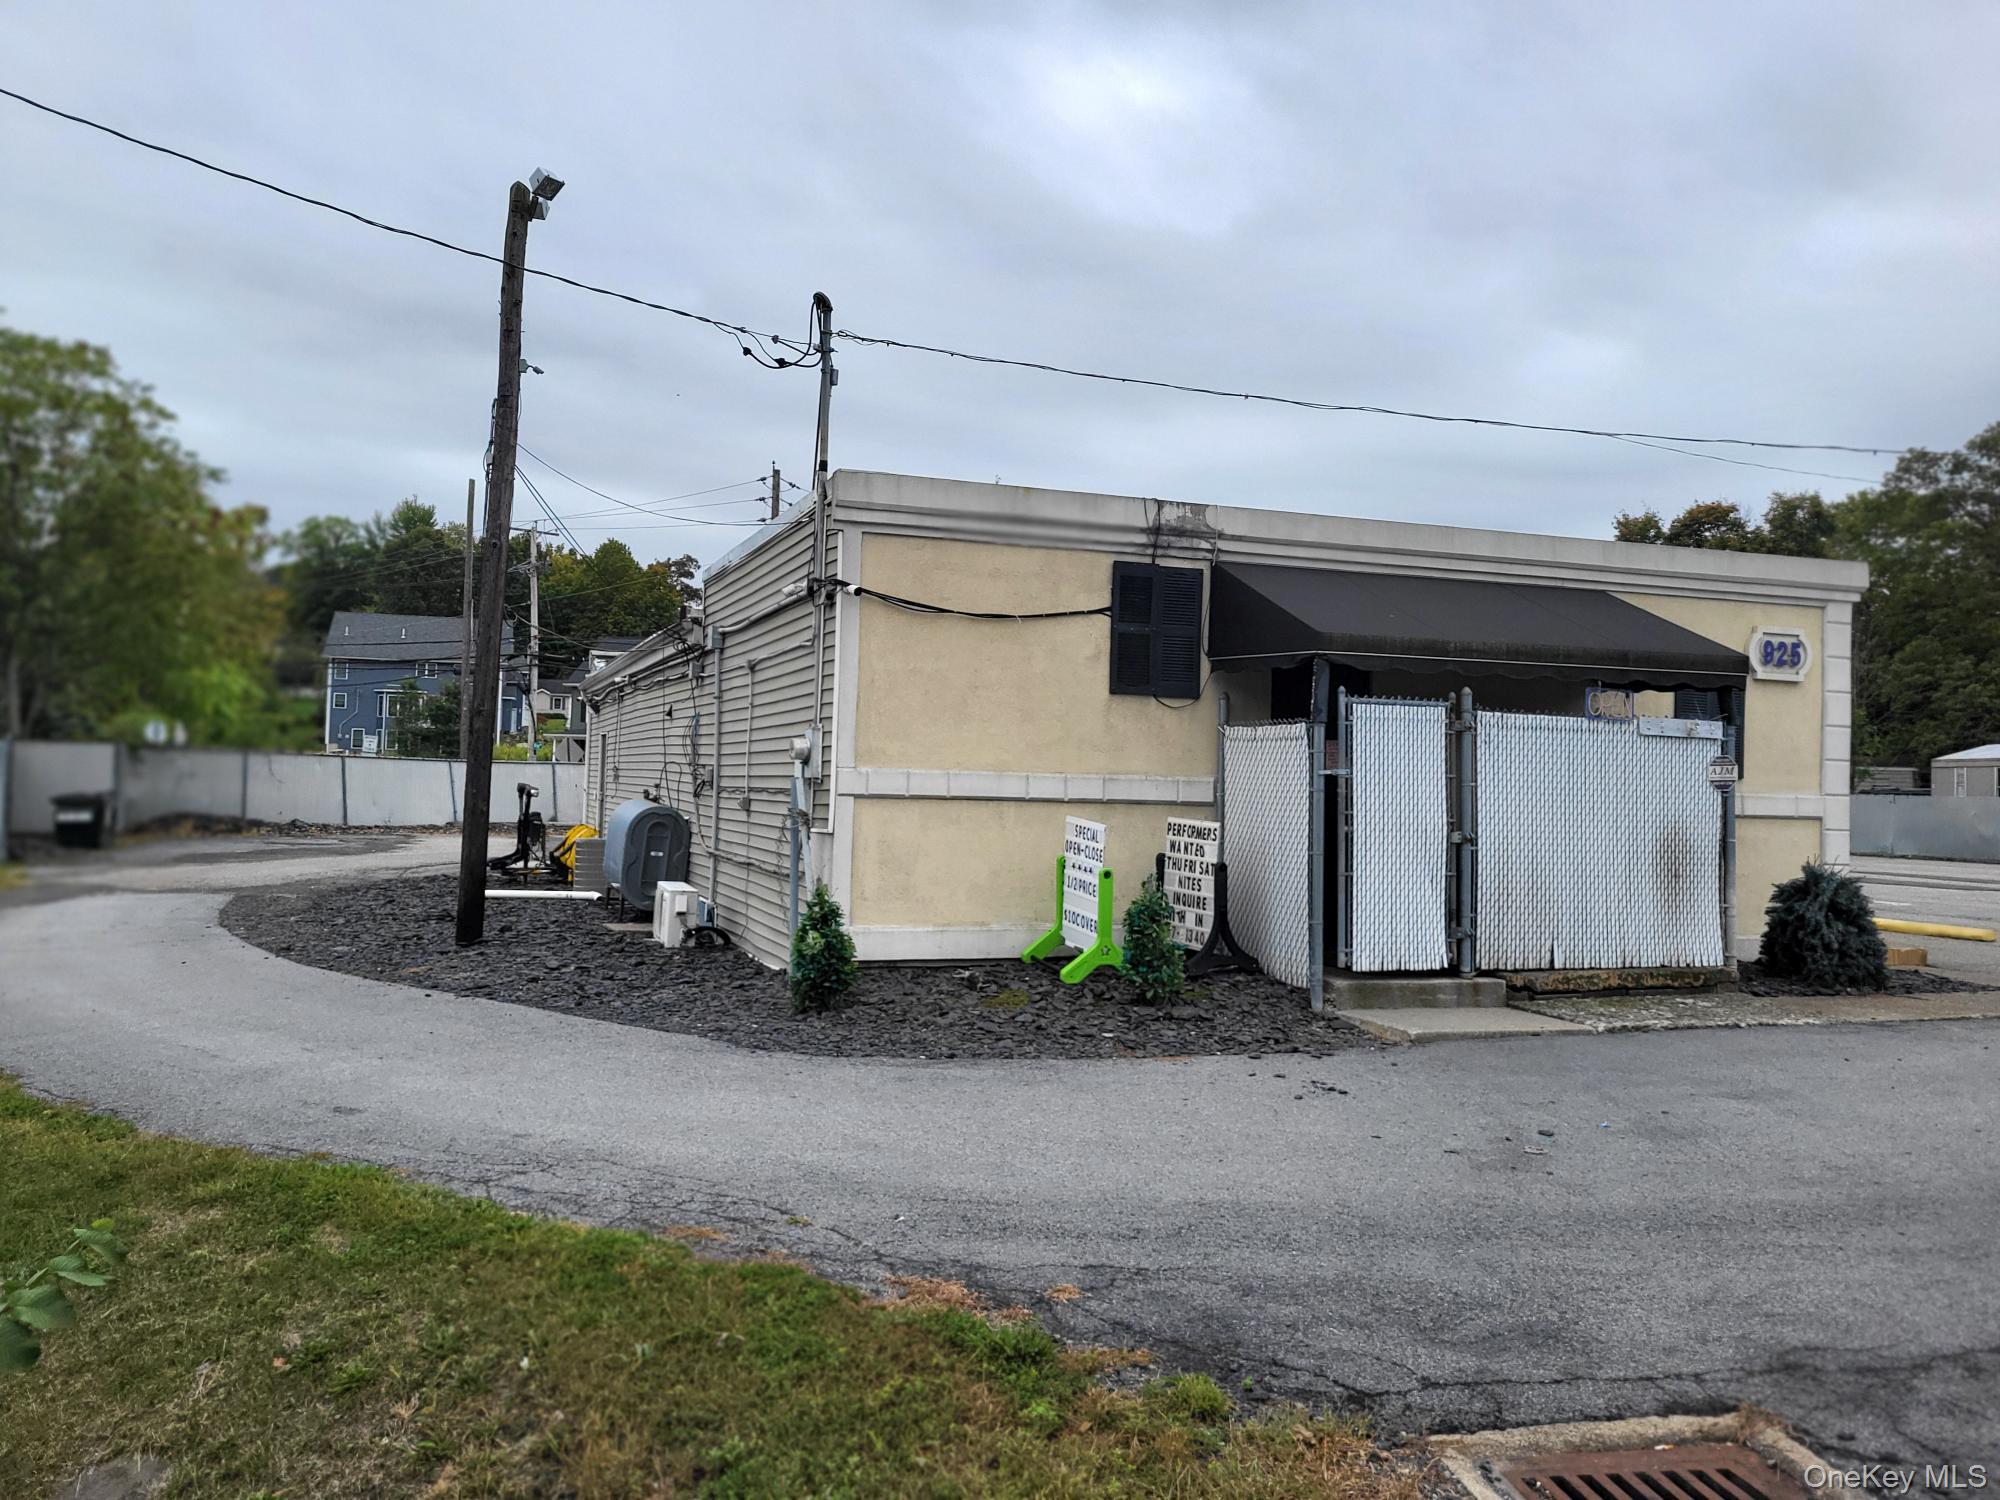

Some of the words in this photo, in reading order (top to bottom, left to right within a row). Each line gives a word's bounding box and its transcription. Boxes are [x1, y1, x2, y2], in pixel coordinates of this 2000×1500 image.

[1074, 824, 1100, 844] SPECIAL
[1065, 839, 1103, 863] OPEN-CLOSE
[1170, 839, 1205, 858] WANTED
[1167, 856, 1182, 871] THU
[1183, 859, 1197, 874] FRI
[1199, 861, 1215, 877] SAT
[1178, 874, 1202, 892] NITES
[1173, 891, 1207, 911] INQUIRE
[1194, 913, 1204, 928] IN
